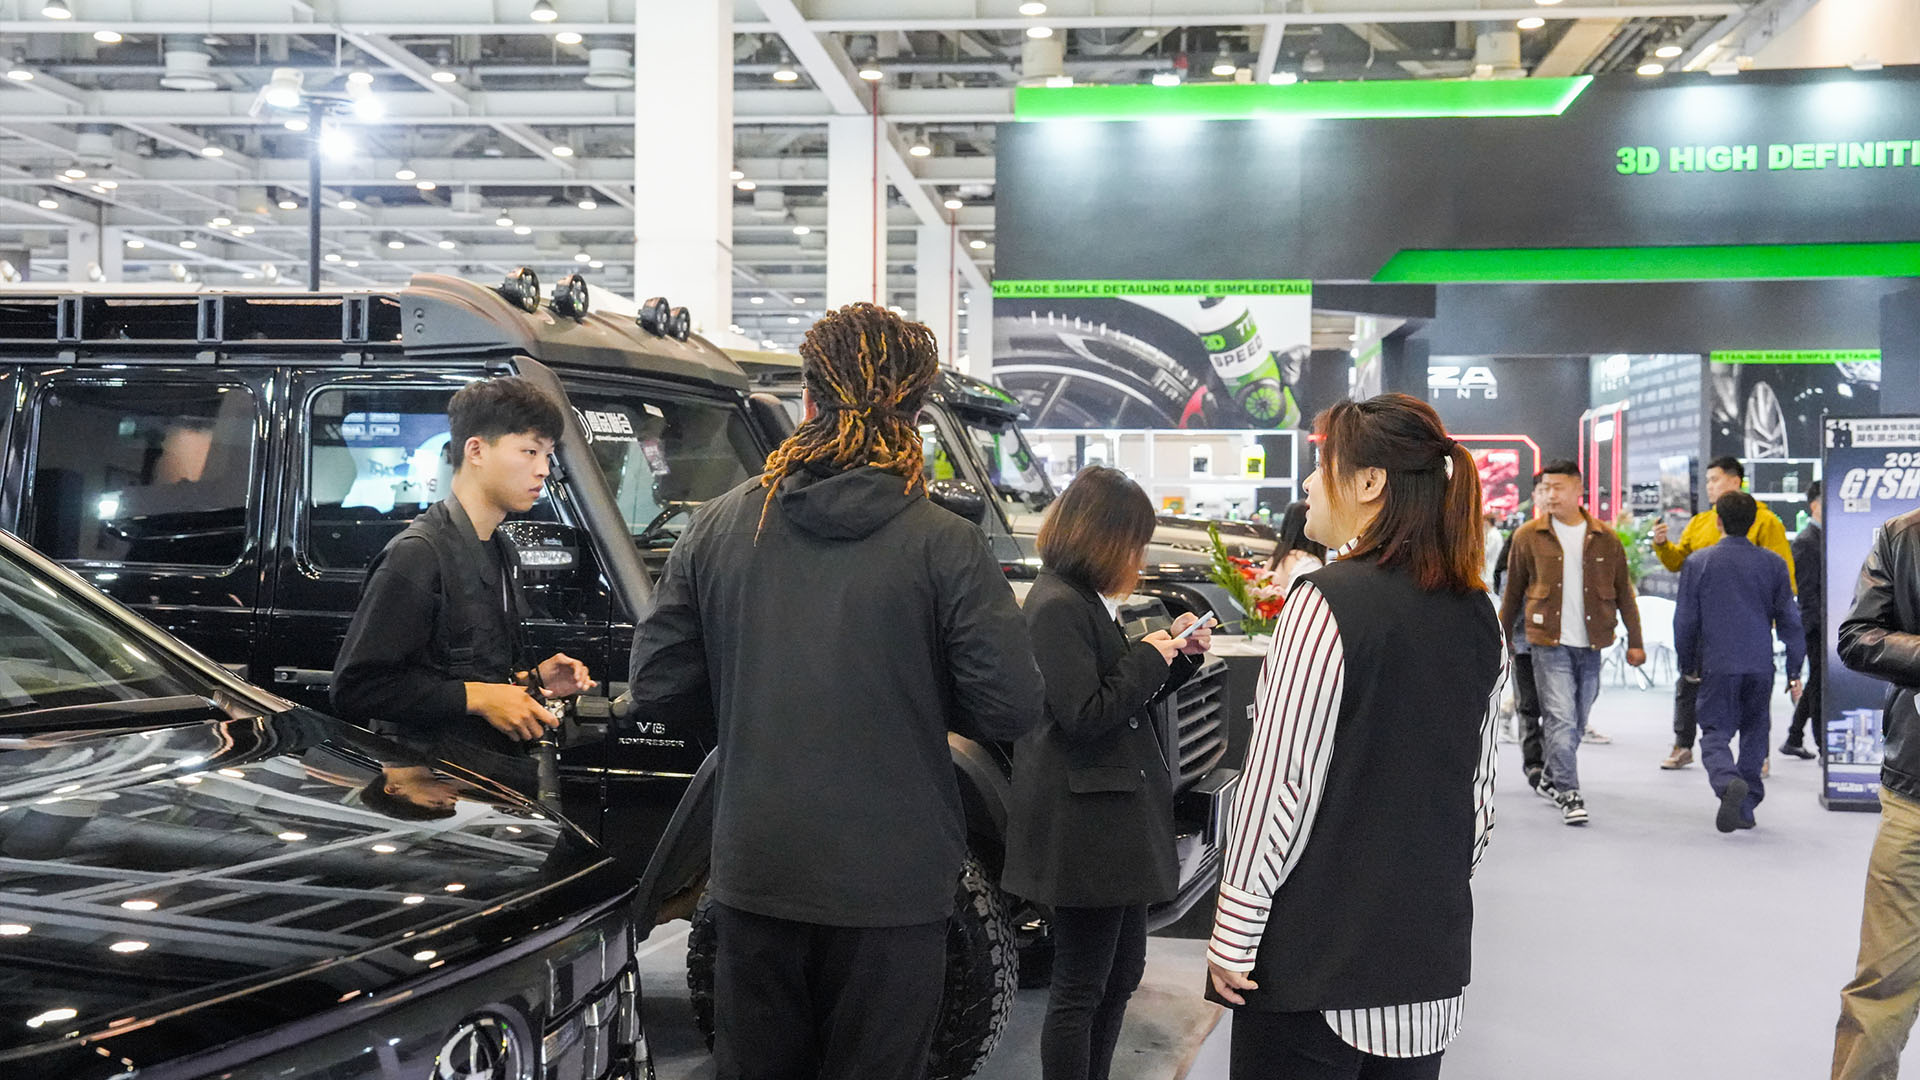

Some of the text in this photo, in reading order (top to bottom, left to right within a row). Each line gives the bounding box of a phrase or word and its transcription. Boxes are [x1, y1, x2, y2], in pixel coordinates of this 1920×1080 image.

[1616, 146, 1660, 175] 3D
[1669, 144, 1758, 172] HIGH
[1015, 285, 1049, 294] MADE
[1054, 285, 1099, 294] SIMPLE
[1103, 284, 1170, 294] DETAILING
[1175, 284, 1210, 293] MADE
[636, 722, 665, 735] V8
